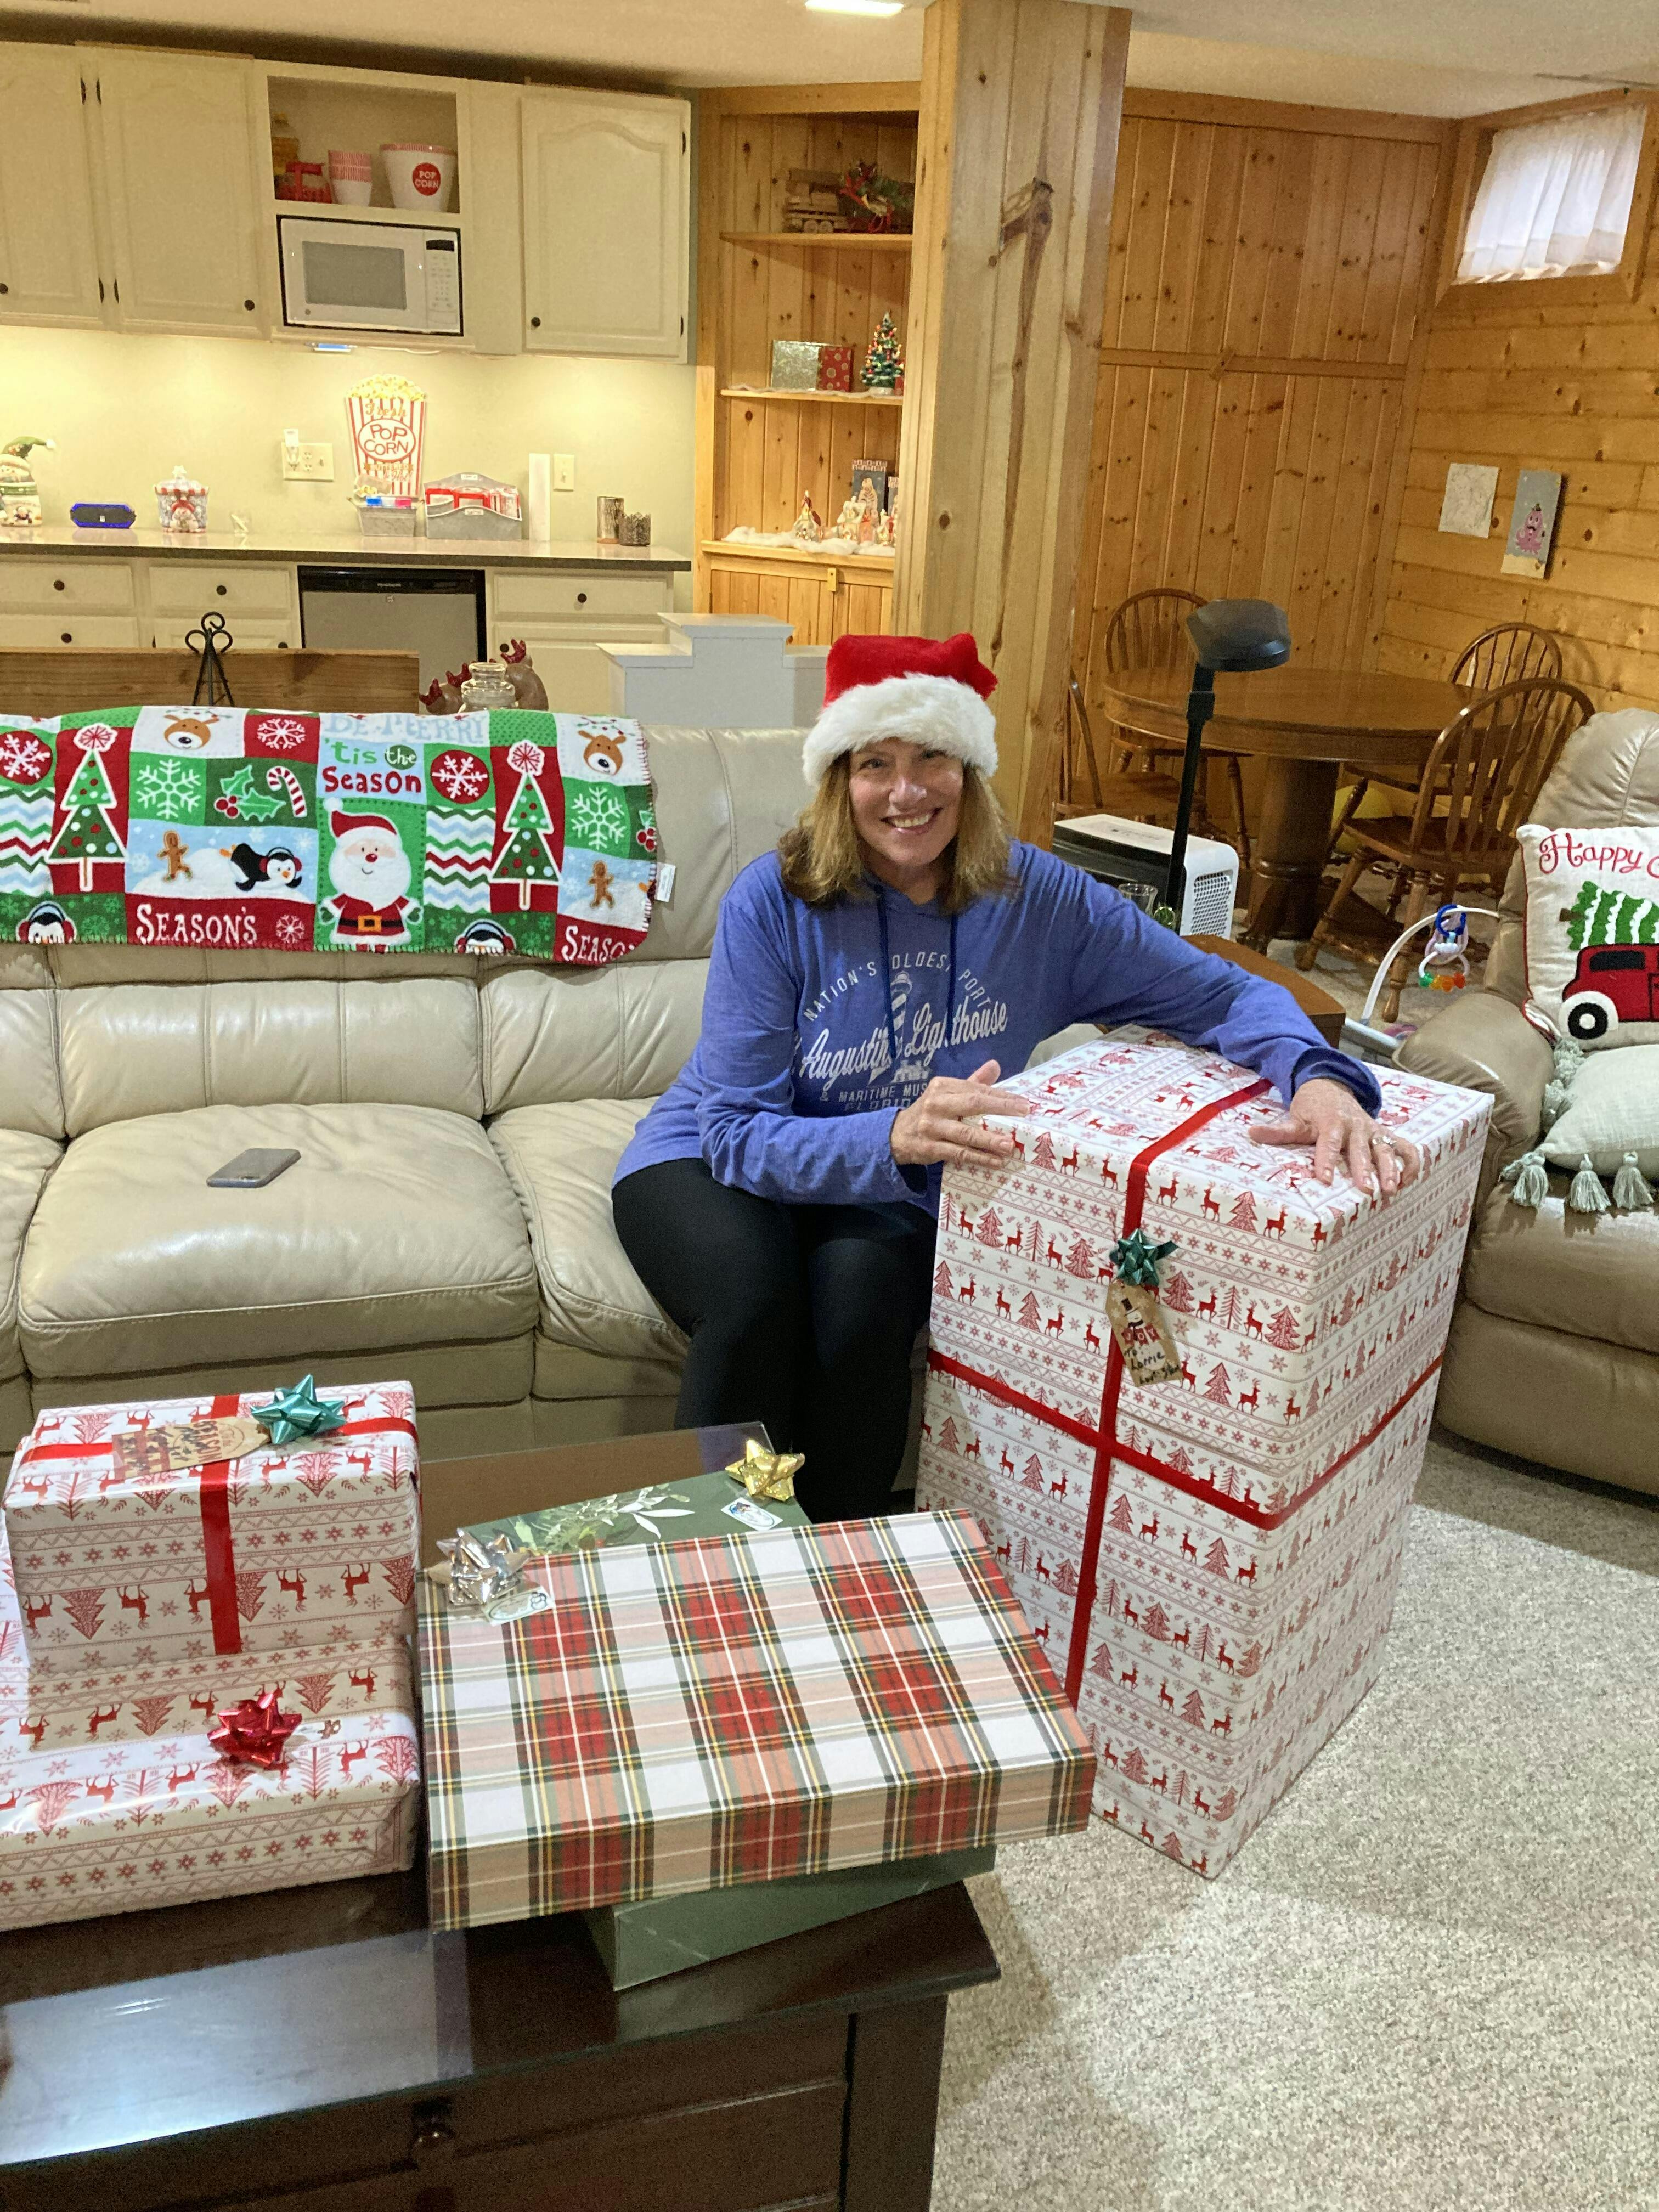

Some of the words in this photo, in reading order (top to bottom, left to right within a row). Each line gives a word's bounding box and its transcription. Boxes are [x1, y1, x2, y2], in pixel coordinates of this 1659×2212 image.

[415, 179, 439, 188] CORN
[419, 171, 437, 179] POP
[365, 401, 407, 417] Fresh
[370, 424, 408, 441] POP
[364, 439, 409, 455] CORN
[325, 738, 377, 764] 'tis
[385, 745, 417, 766] the
[322, 766, 422, 794] Season
[1539, 832, 1644, 874] Happy
[136, 904, 257, 945] SEASON'S
[561, 925, 635, 963] SEASO
[803, 961, 878, 1022] NATION'S
[958, 968, 992, 1008] PORT
[799, 1028, 893, 1092] Augustin
[838, 1085, 896, 1103] MARITIME
[903, 1082, 928, 1097] MUS
[844, 1098, 912, 1111] FLORID
[1126, 1329, 1155, 1340] JOY
